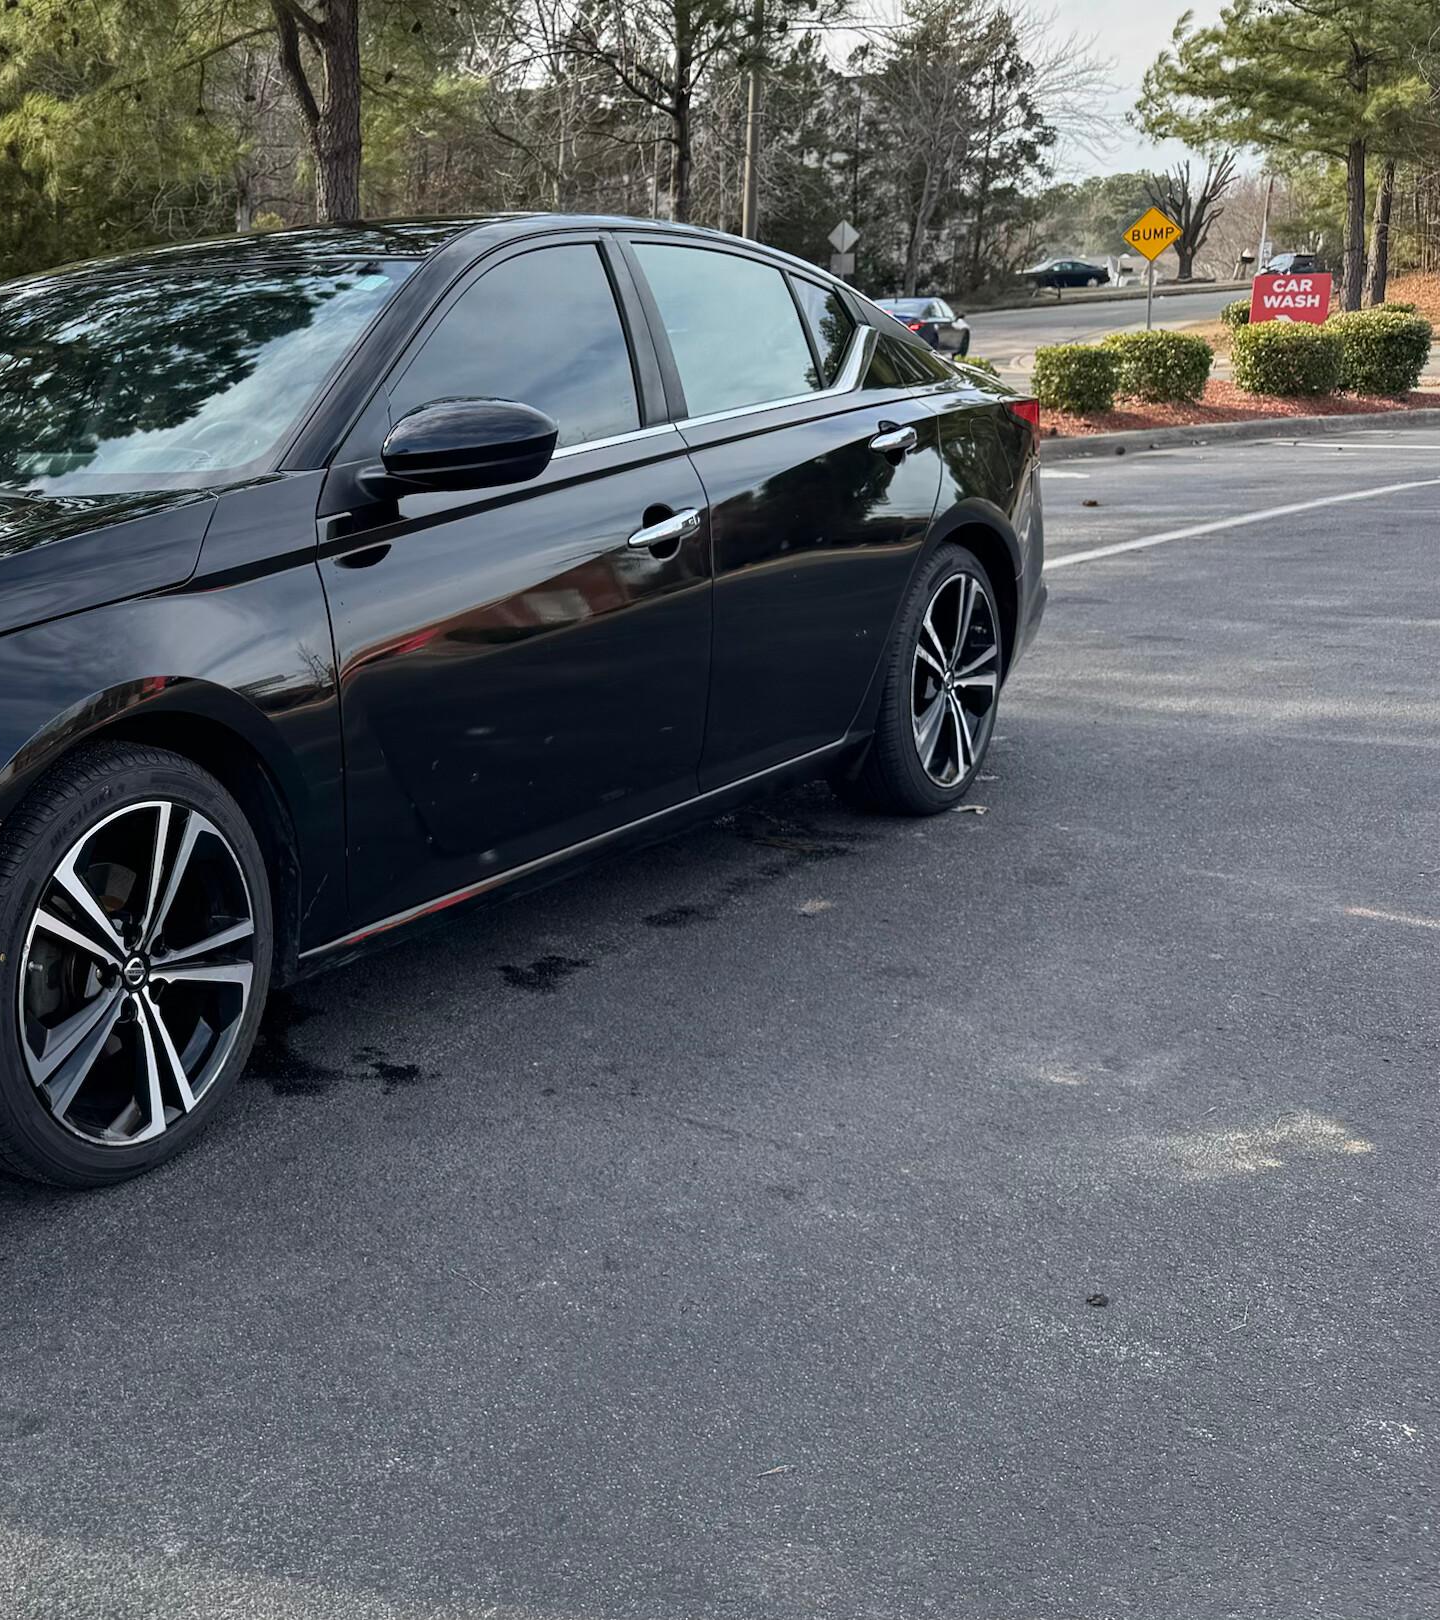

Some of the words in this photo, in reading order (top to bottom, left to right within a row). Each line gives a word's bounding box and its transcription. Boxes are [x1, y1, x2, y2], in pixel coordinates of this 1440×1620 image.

[1132, 227, 1174, 241] BUMP
[1272, 279, 1313, 293] CAR
[1263, 294, 1320, 308] WASH
